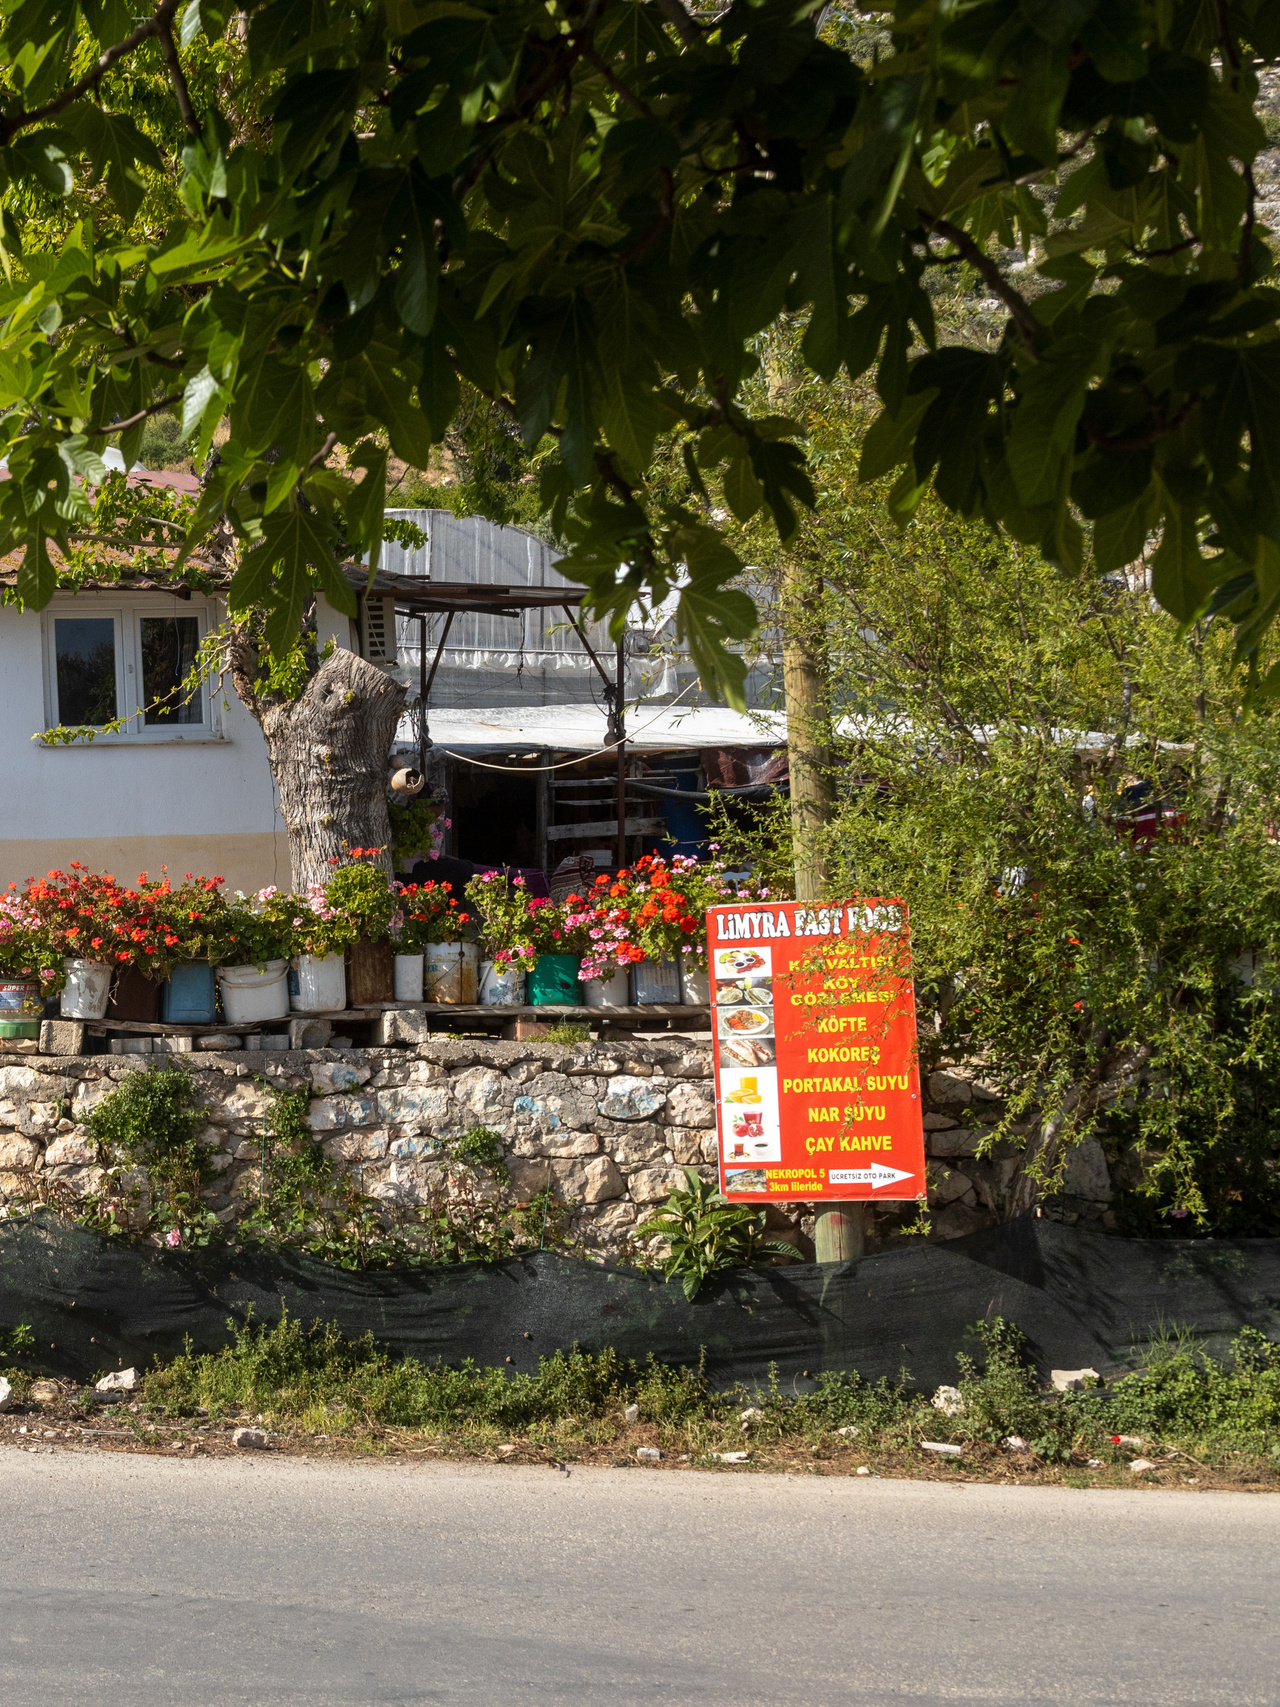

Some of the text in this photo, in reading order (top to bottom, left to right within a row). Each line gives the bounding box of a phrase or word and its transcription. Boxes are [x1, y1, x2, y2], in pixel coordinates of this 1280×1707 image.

[793, 906, 844, 936] FAST
[788, 956, 895, 972] KAVALTISI
[823, 975, 861, 990] KÖY
[817, 1015, 868, 1034] KÖFTE
[807, 1046, 881, 1066] KOKOREÇ
[783, 1075, 909, 1094] PORTAKAL SUYU
[808, 1105, 886, 1123] NAR SUYU
[805, 1135, 893, 1156] ÇAY KAHVE
[765, 1168, 826, 1179] NEKROPOL 5
[769, 1181, 790, 1192] 3km
